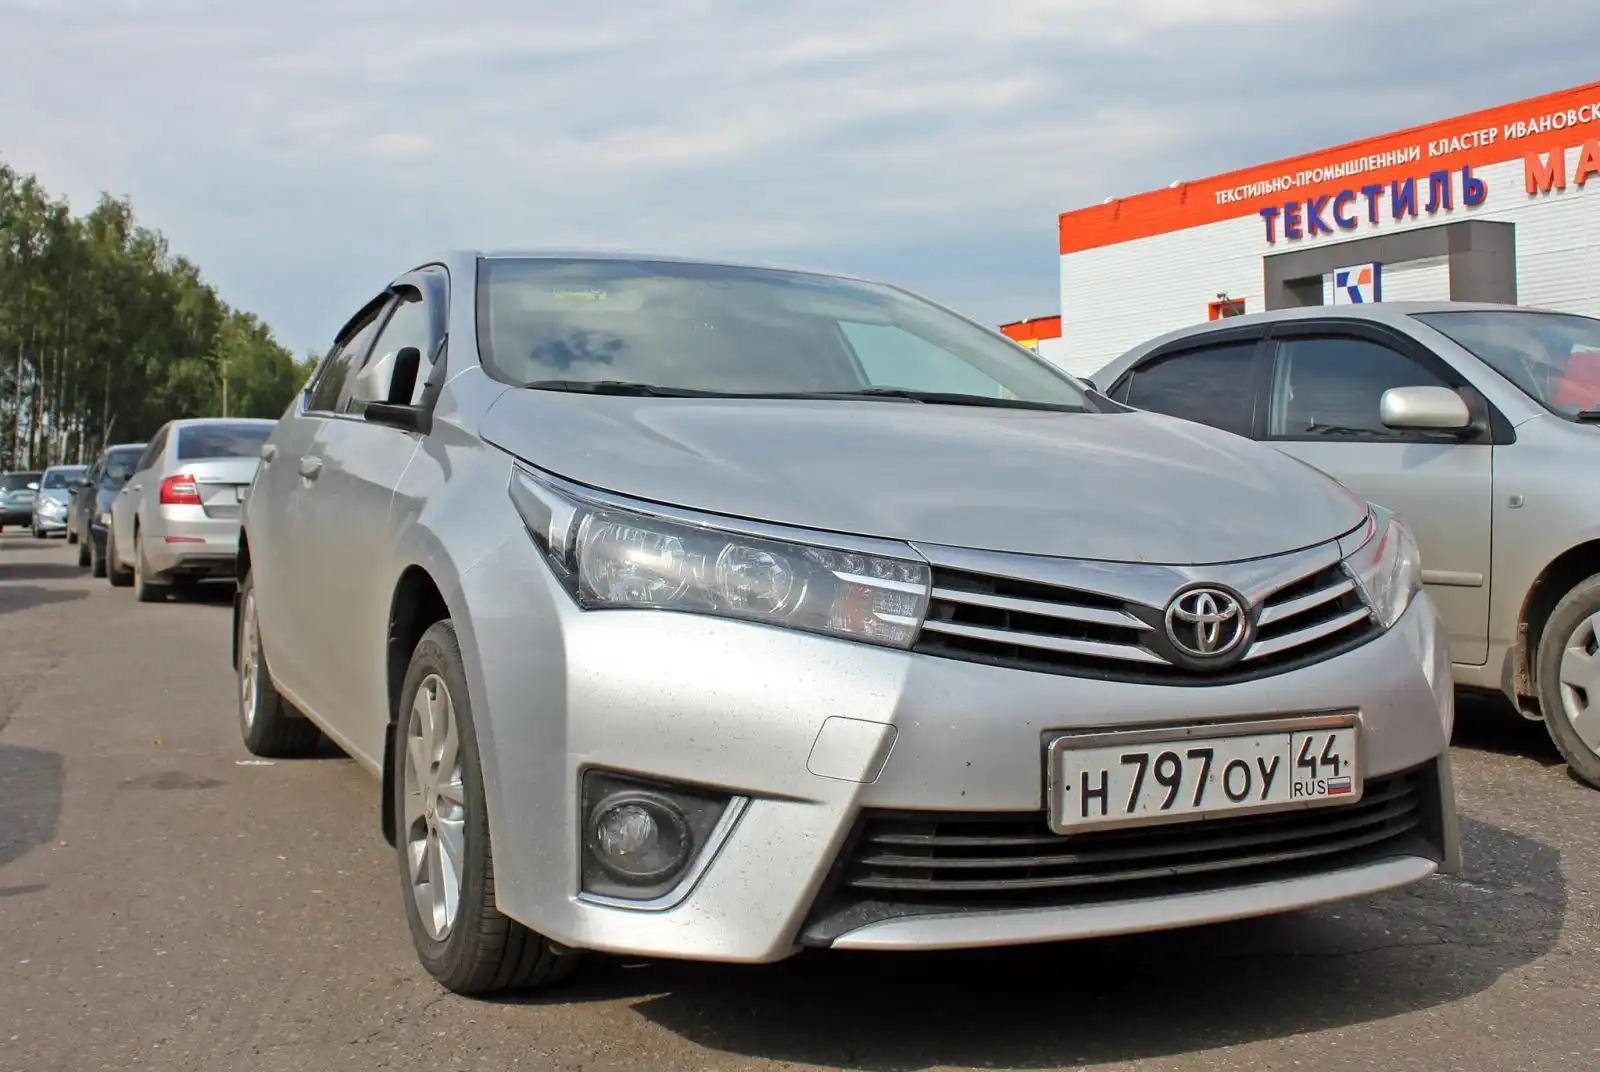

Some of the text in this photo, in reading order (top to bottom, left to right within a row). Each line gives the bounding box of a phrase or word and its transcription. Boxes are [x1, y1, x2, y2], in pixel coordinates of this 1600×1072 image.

[1428, 127, 1498, 157] КЛАСТЕР
[1260, 165, 1488, 243] ТЕКСТИЛЬ
[1296, 734, 1340, 779] 44
[1293, 780, 1326, 797] RUS
